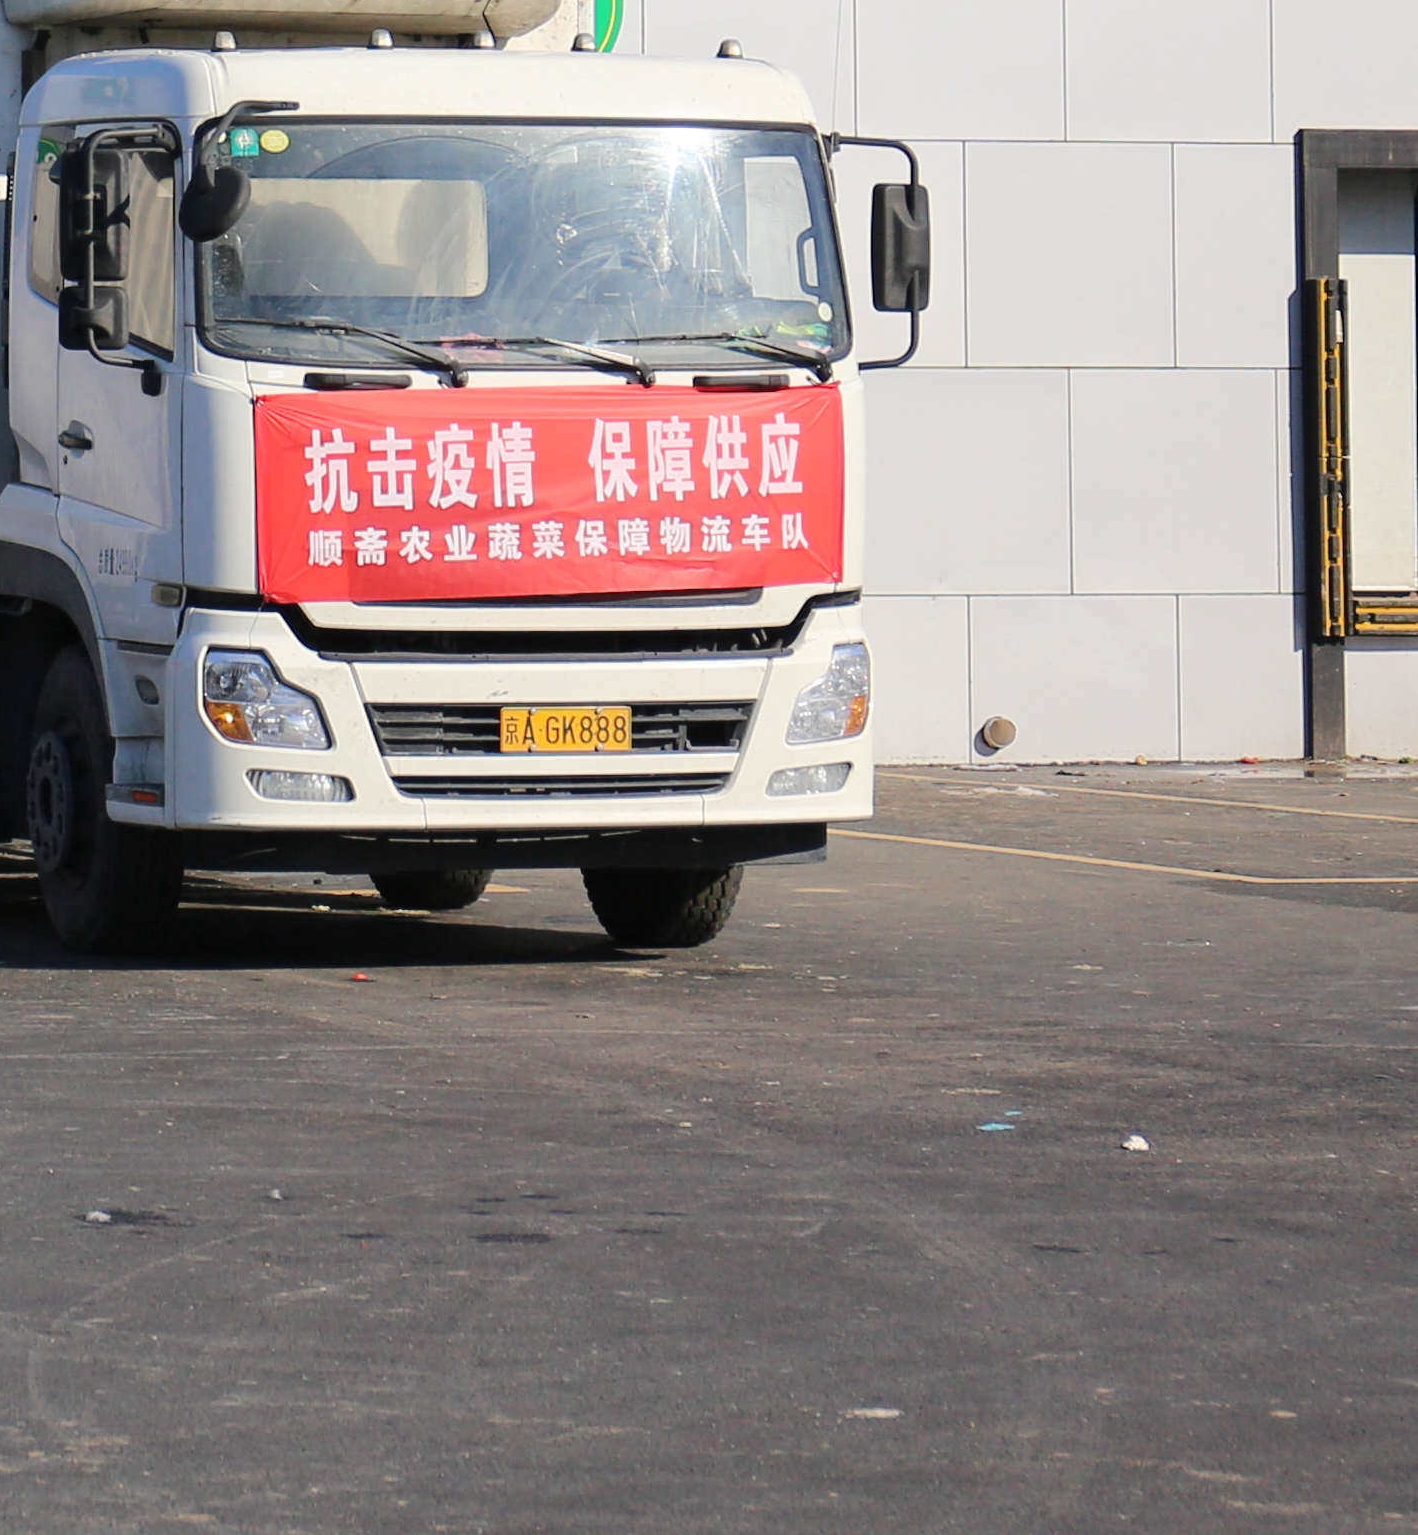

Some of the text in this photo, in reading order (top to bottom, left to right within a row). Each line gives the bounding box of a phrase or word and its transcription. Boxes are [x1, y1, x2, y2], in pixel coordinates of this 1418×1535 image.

[305, 412, 802, 513] 抗击疫情 保障供应
[308, 512, 808, 566] 顺斋农业蔬菜保障物流车队
